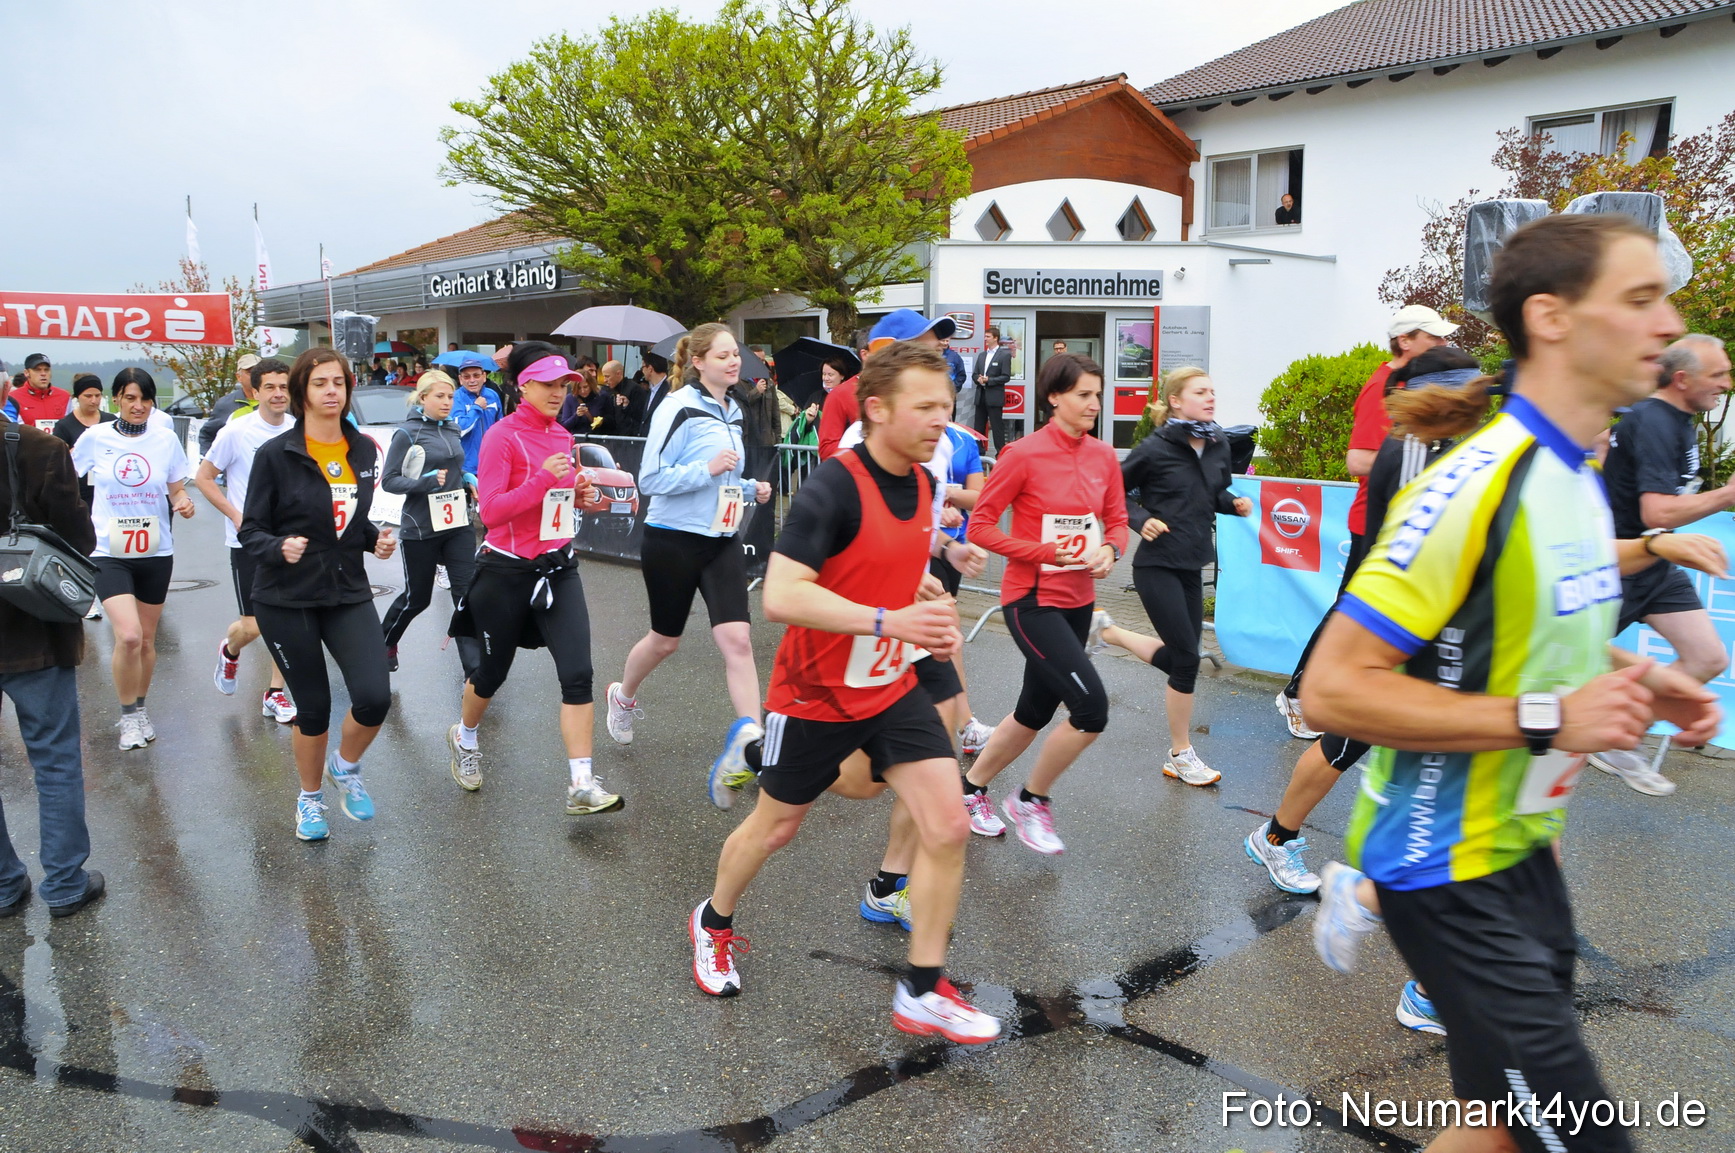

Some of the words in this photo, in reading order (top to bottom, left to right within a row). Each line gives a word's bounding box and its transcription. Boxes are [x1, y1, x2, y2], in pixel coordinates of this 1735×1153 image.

[430, 270, 490, 298] Gerhart
[494, 268, 506, 290] &
[510, 260, 557, 290] Jänig
[985, 270, 1161, 297] Serviceannahme
[949, 346, 981, 354] EAT
[333, 500, 347, 532] 5
[443, 503, 454, 525] 3
[552, 503, 561, 532] 4
[722, 501, 737, 528] 41
[1054, 517, 1083, 526] MEYER
[1273, 513, 1307, 525] NISSAN
[122, 529, 150, 554] 70
[1056, 534, 1087, 561] 72
[868, 636, 904, 678] 24
